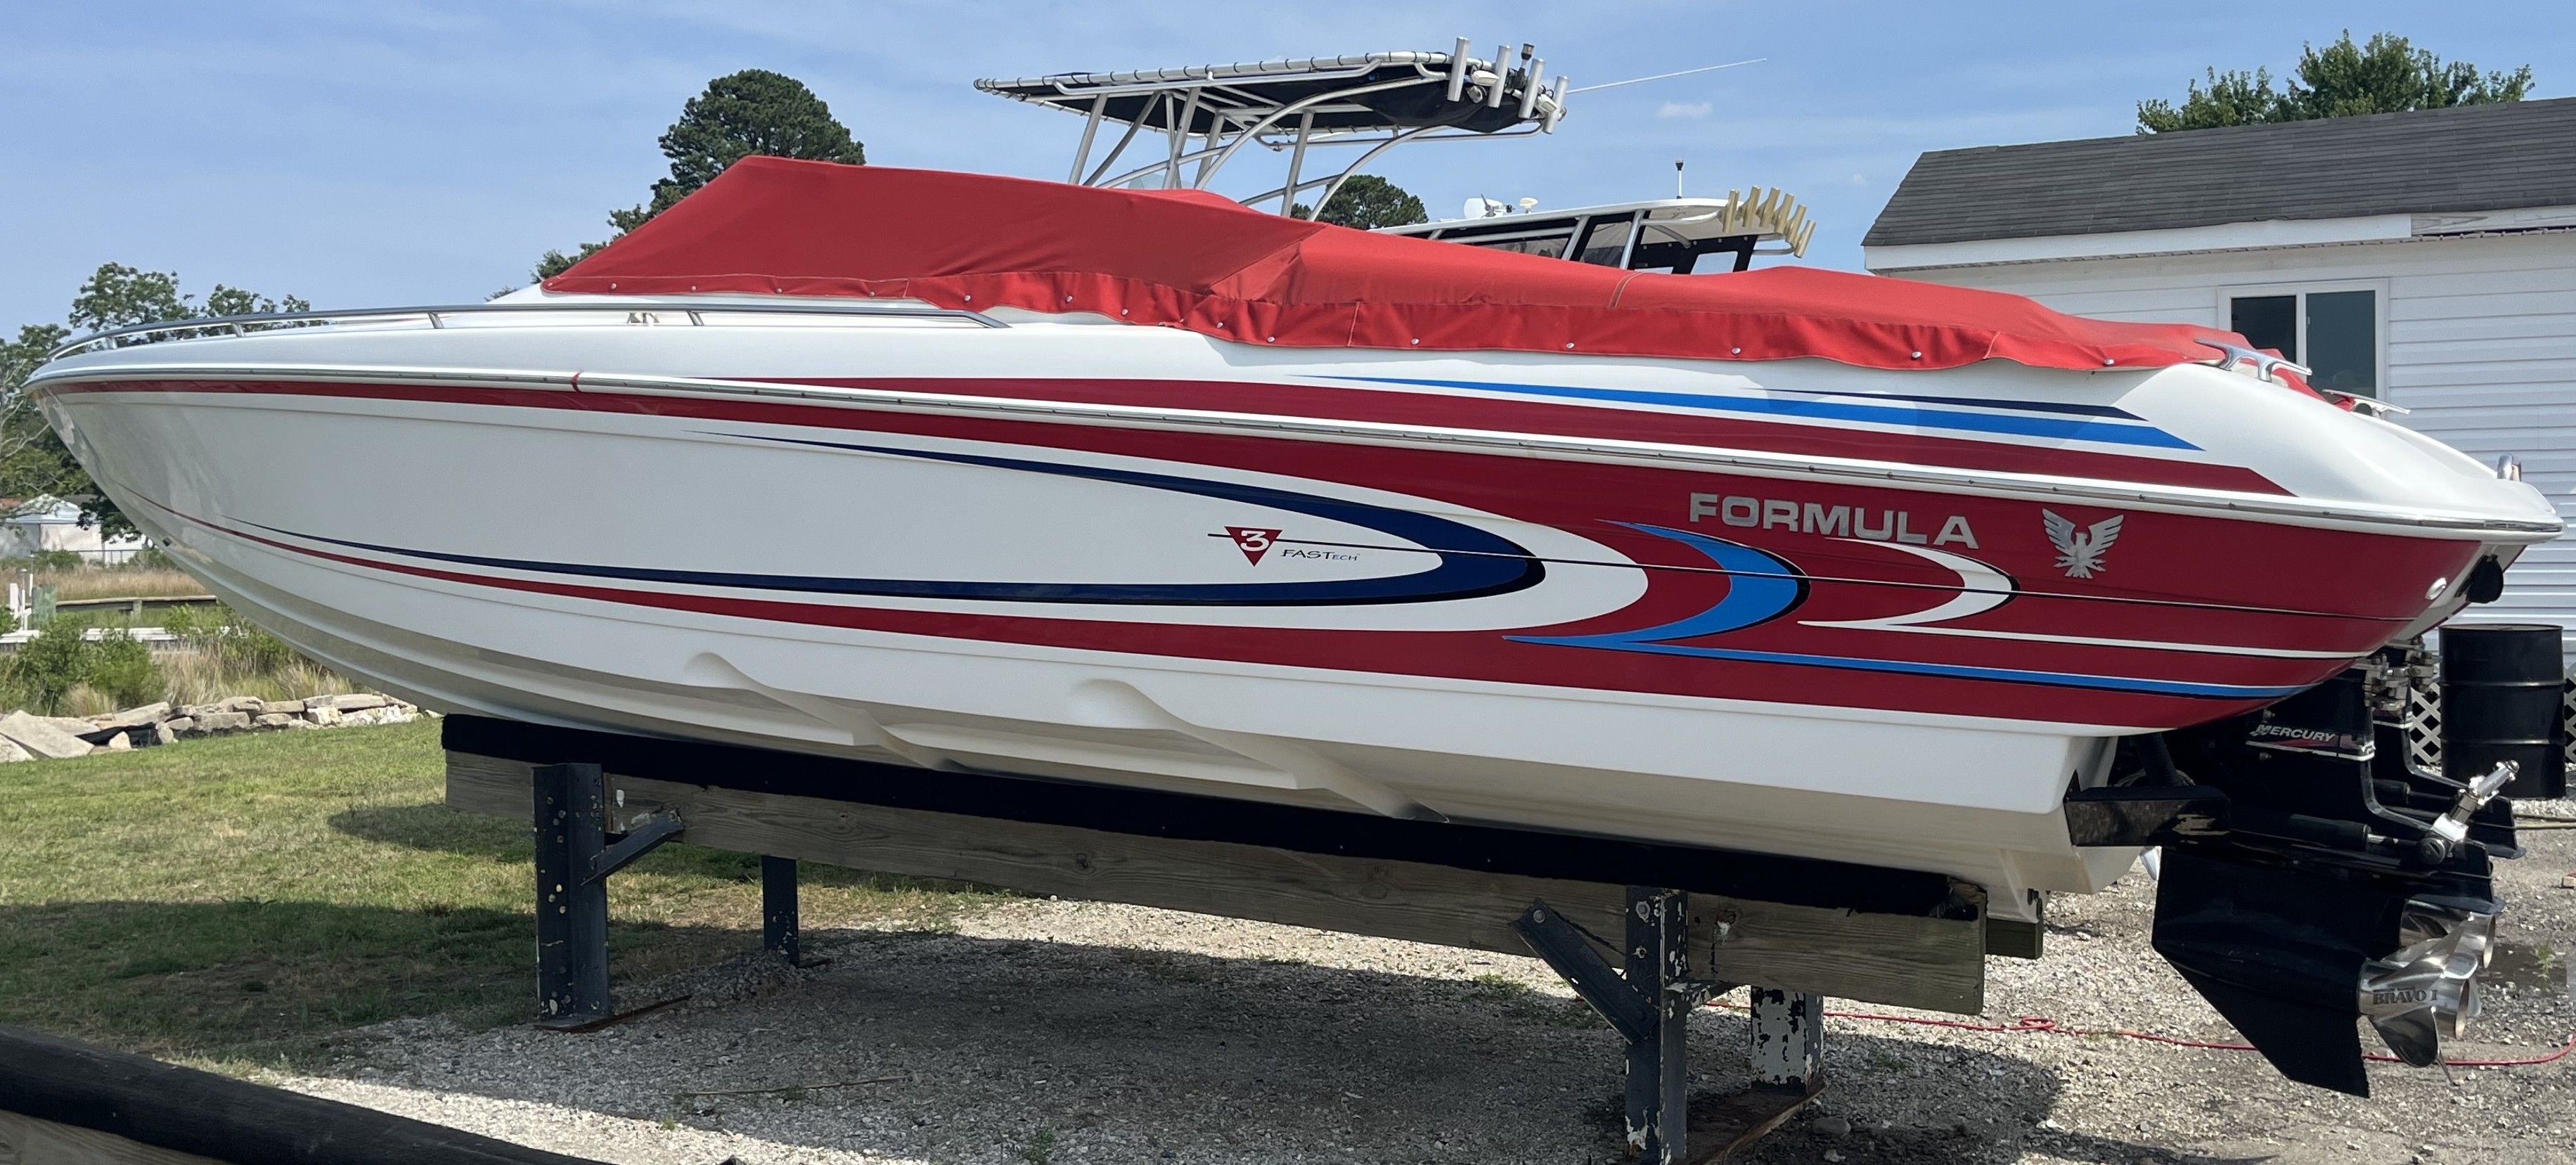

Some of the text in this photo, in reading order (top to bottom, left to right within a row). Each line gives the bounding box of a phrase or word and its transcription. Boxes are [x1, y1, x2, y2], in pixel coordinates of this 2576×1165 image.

[1689, 492, 1979, 549] FORMULA
[1240, 530, 1269, 551] 3
[2251, 724, 2335, 742] MERCURY
[2373, 989, 2425, 1005] BRAVO
